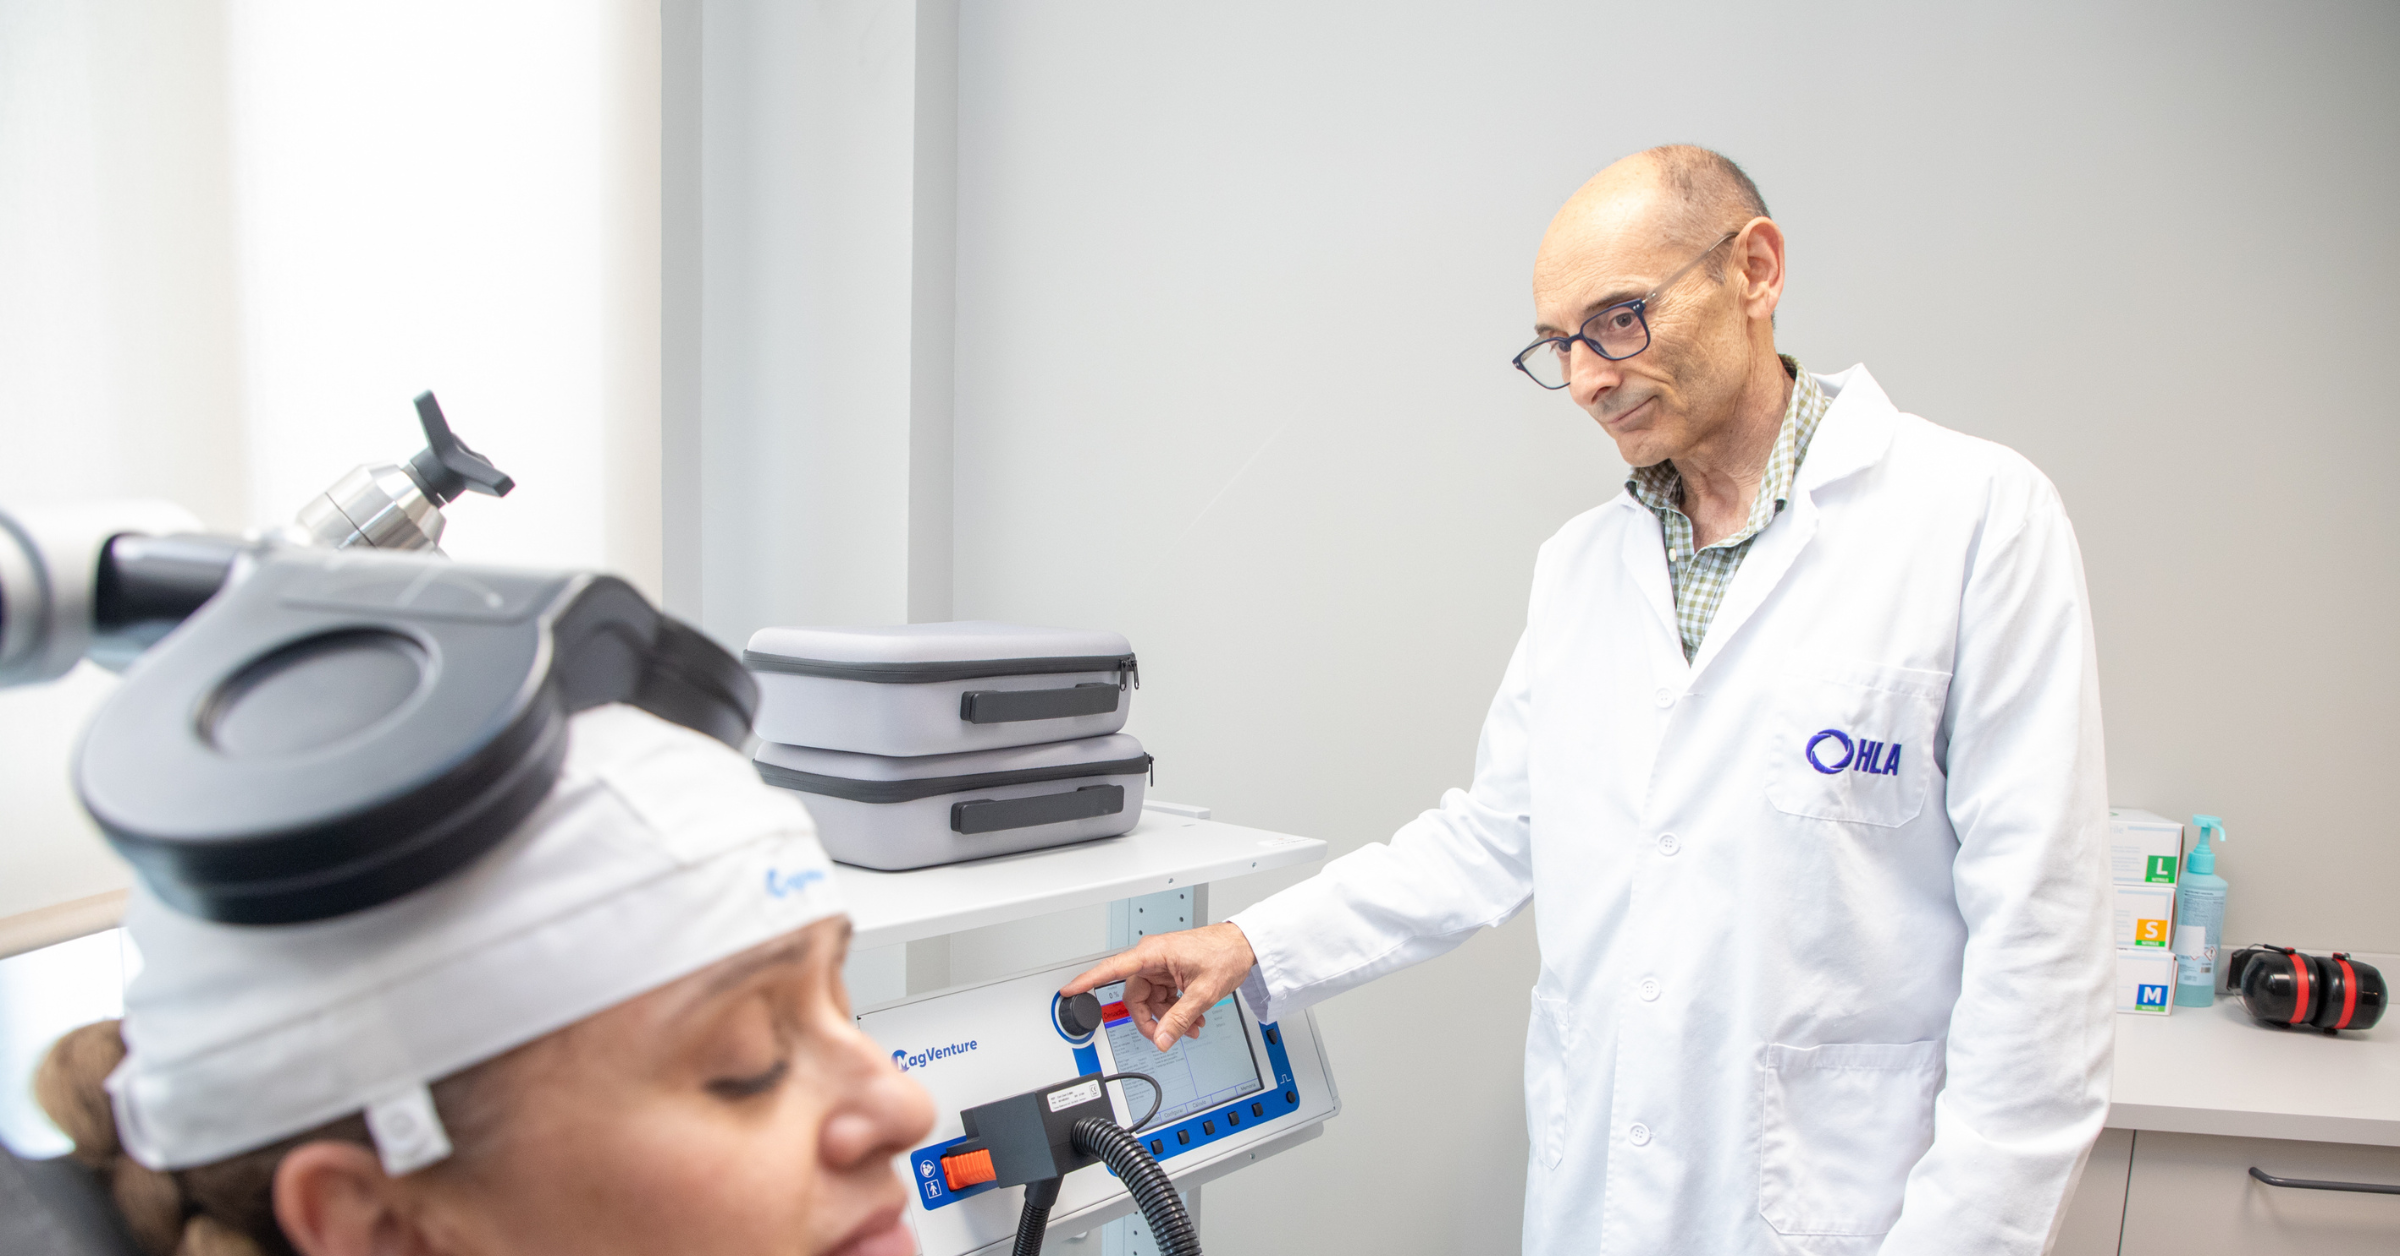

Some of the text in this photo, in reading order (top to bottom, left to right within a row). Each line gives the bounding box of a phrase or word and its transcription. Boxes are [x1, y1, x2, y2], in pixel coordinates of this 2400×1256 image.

[1853, 738, 1902, 776] HLA
[2156, 858, 2168, 875] L
[2145, 921, 2158, 939] S
[2143, 986, 2162, 1004] M
[893, 1040, 977, 1072] MagVenture
